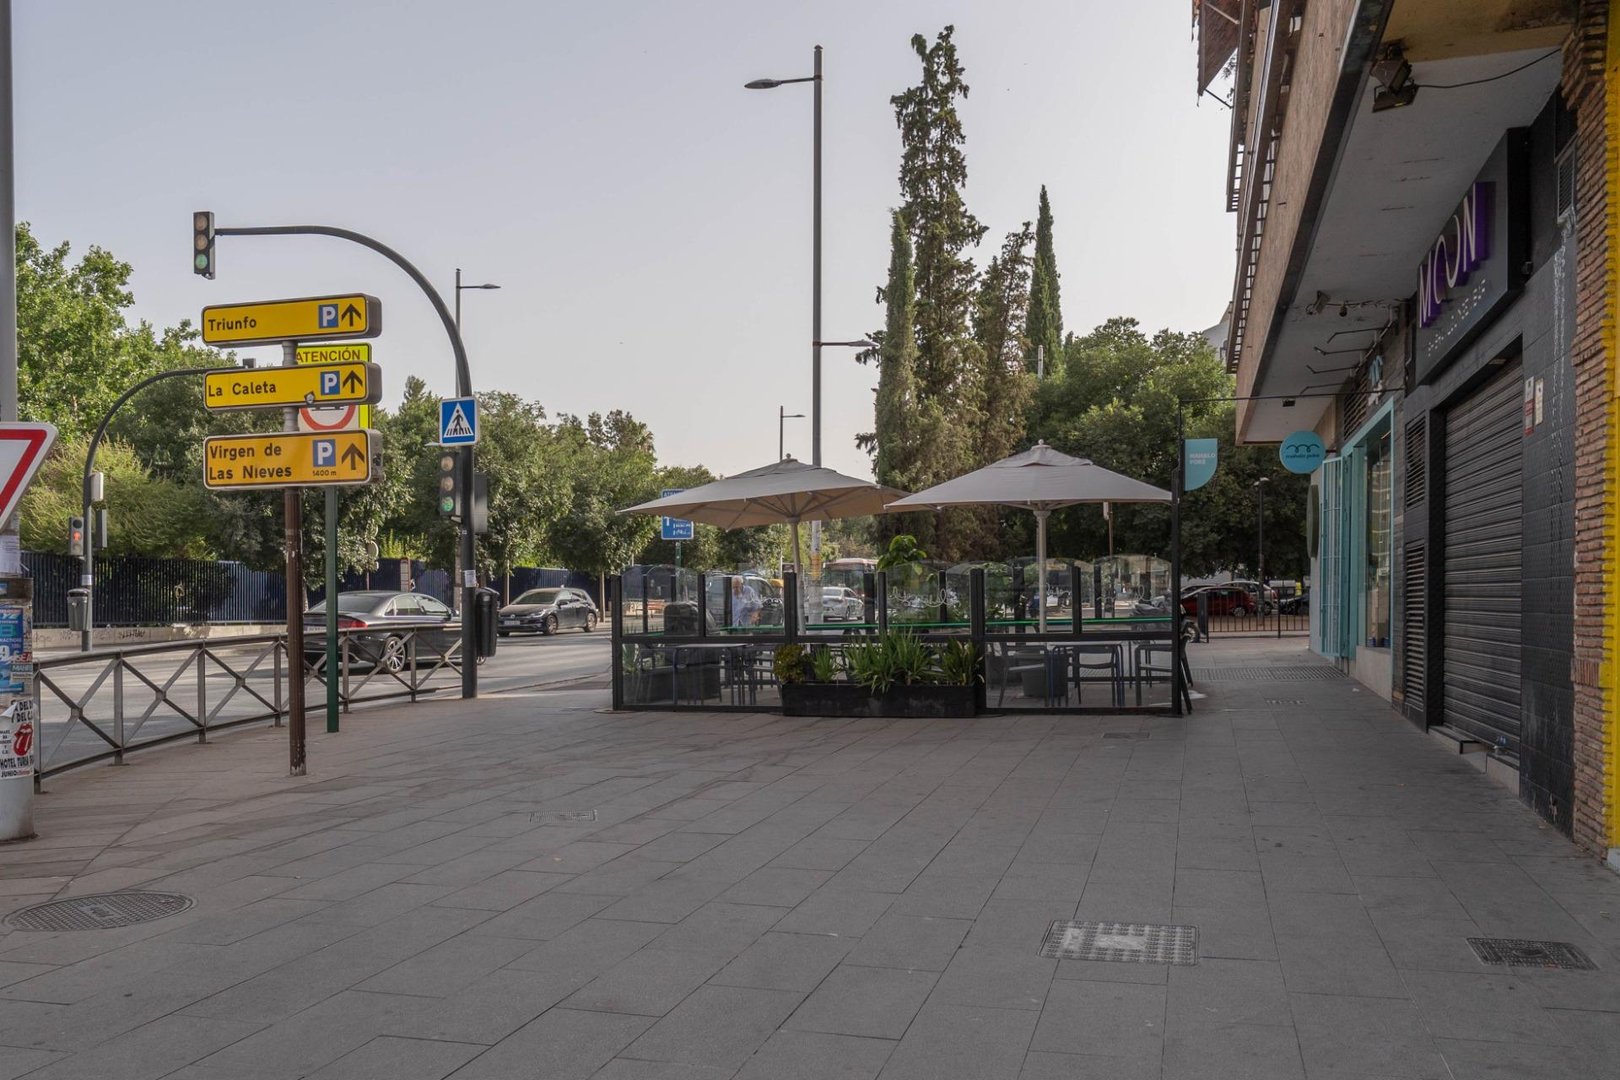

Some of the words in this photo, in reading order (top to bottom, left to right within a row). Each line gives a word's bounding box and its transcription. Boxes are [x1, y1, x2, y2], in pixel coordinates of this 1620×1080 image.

[208, 316, 257, 332] Triunfo
[322, 306, 337, 327] P
[296, 347, 361, 363] ATENCIÓN
[208, 384, 223, 397] La
[232, 381, 276, 395] Caleta
[324, 373, 338, 393] P
[209, 444, 255, 461] Virgen
[264, 443, 281, 457] de
[317, 442, 333, 465] P
[209, 467, 234, 480] Las
[243, 465, 292, 478] Nieves
